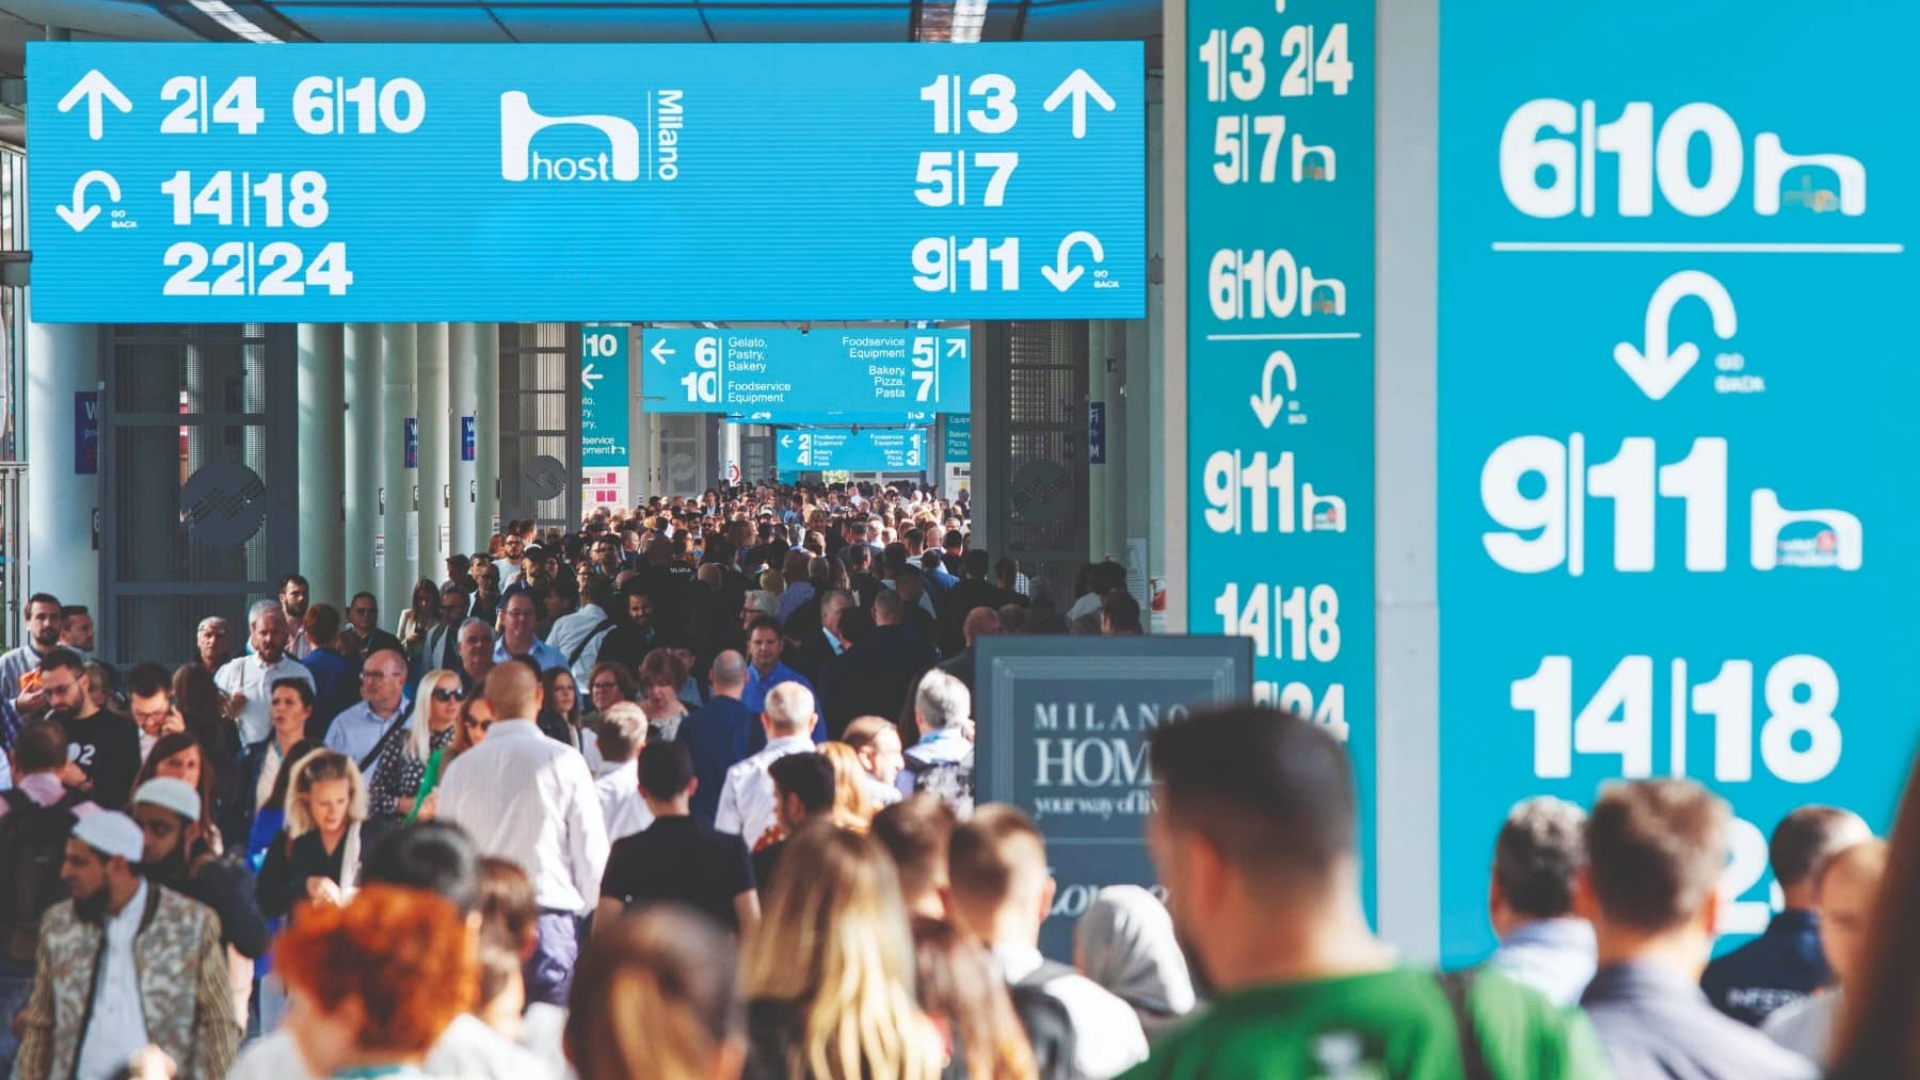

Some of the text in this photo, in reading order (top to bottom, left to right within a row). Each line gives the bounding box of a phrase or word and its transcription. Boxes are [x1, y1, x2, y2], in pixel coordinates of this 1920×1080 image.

[658, 90, 683, 180] Milano
[533, 151, 609, 181] host
[728, 337, 768, 348] Gelato,
[842, 336, 905, 346] Foodservice
[695, 336, 717, 368] 6
[728, 349, 765, 361] Pastry,
[849, 347, 905, 360] Equipment
[911, 336, 934, 368] 5
[728, 361, 767, 373] Bakery
[681, 371, 717, 402] 10
[728, 381, 791, 391] Foodservice
[874, 377, 905, 387] Pizza,
[911, 371, 934, 402] 7
[728, 392, 784, 404] Equipment
[875, 388, 905, 398] Pasta
